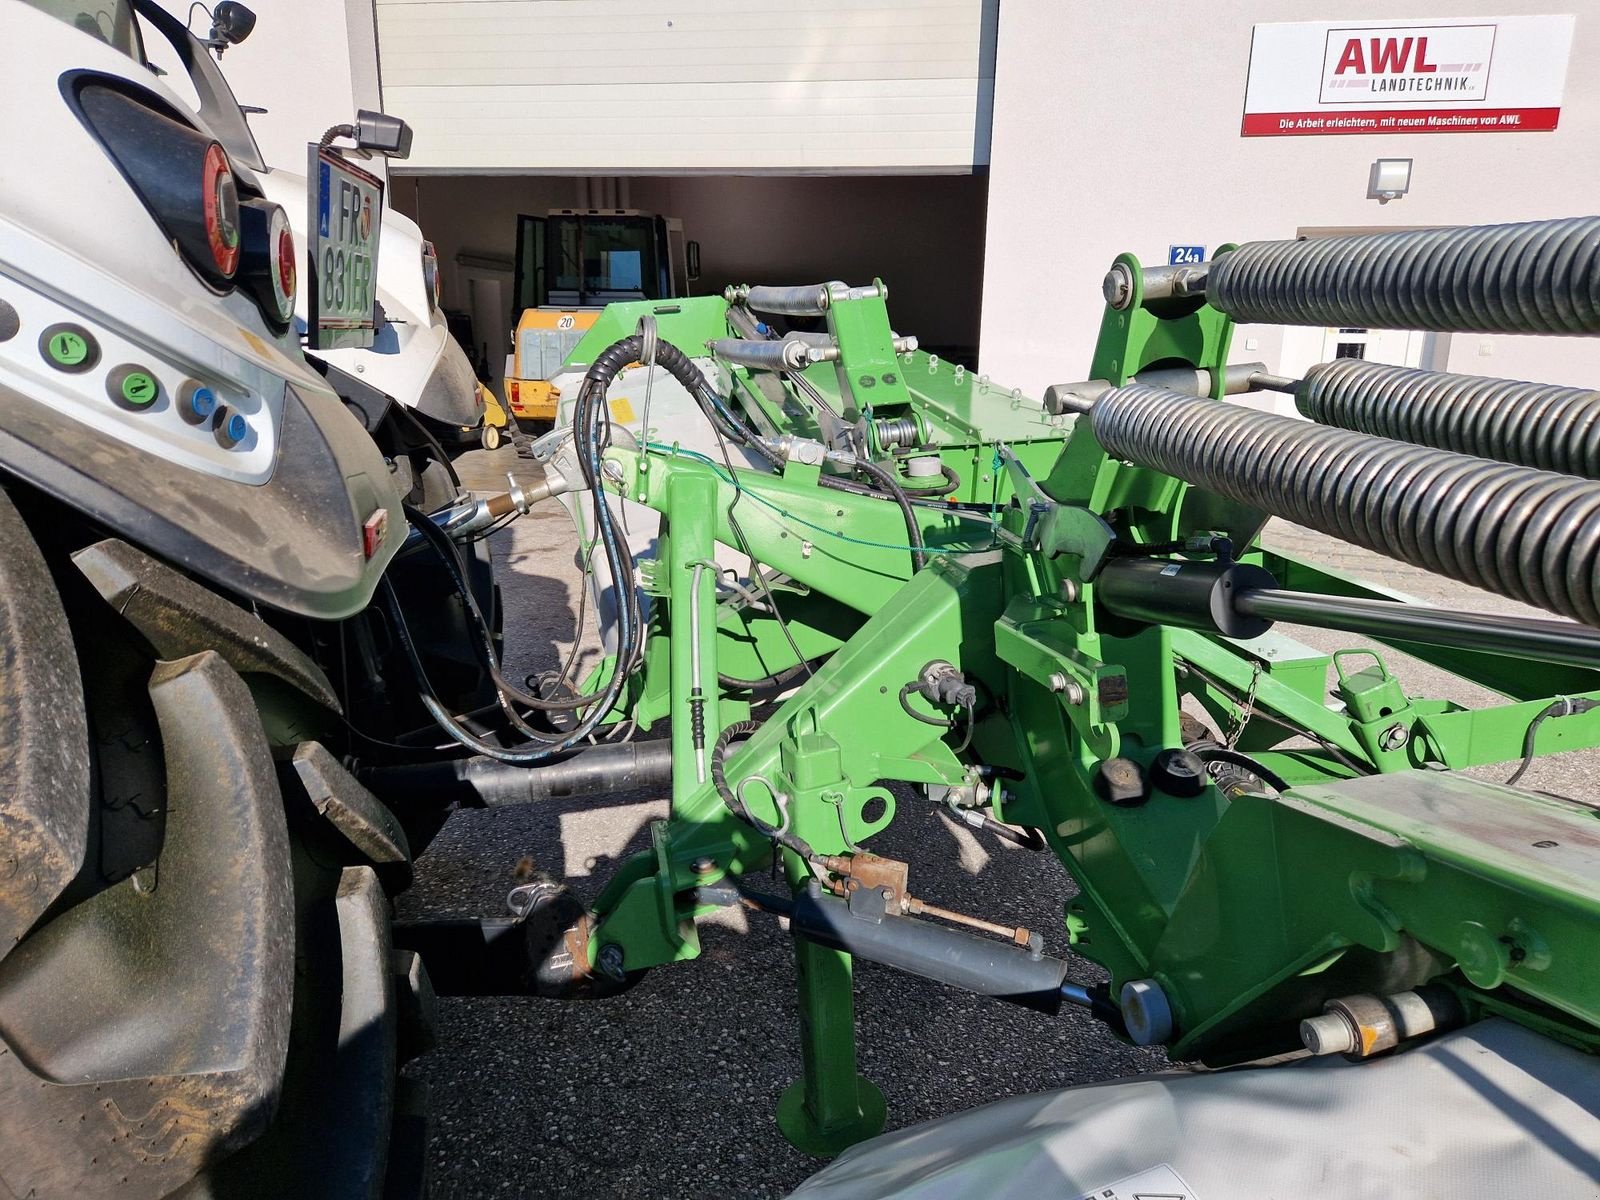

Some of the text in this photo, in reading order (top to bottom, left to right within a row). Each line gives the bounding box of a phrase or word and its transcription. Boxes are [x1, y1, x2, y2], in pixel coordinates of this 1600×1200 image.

[1334, 37, 1437, 75] AWL
[1371, 77, 1468, 92] LANDTECHNIK
[1279, 115, 1521, 129] Die Arbeit erleichtern, mit neuen Maschinen von AWL
[339, 179, 361, 247] FR
[320, 213, 327, 232] A
[1175, 247, 1200, 263] 24a
[325, 246, 371, 313] 831ER
[560, 317, 573, 329] 20
